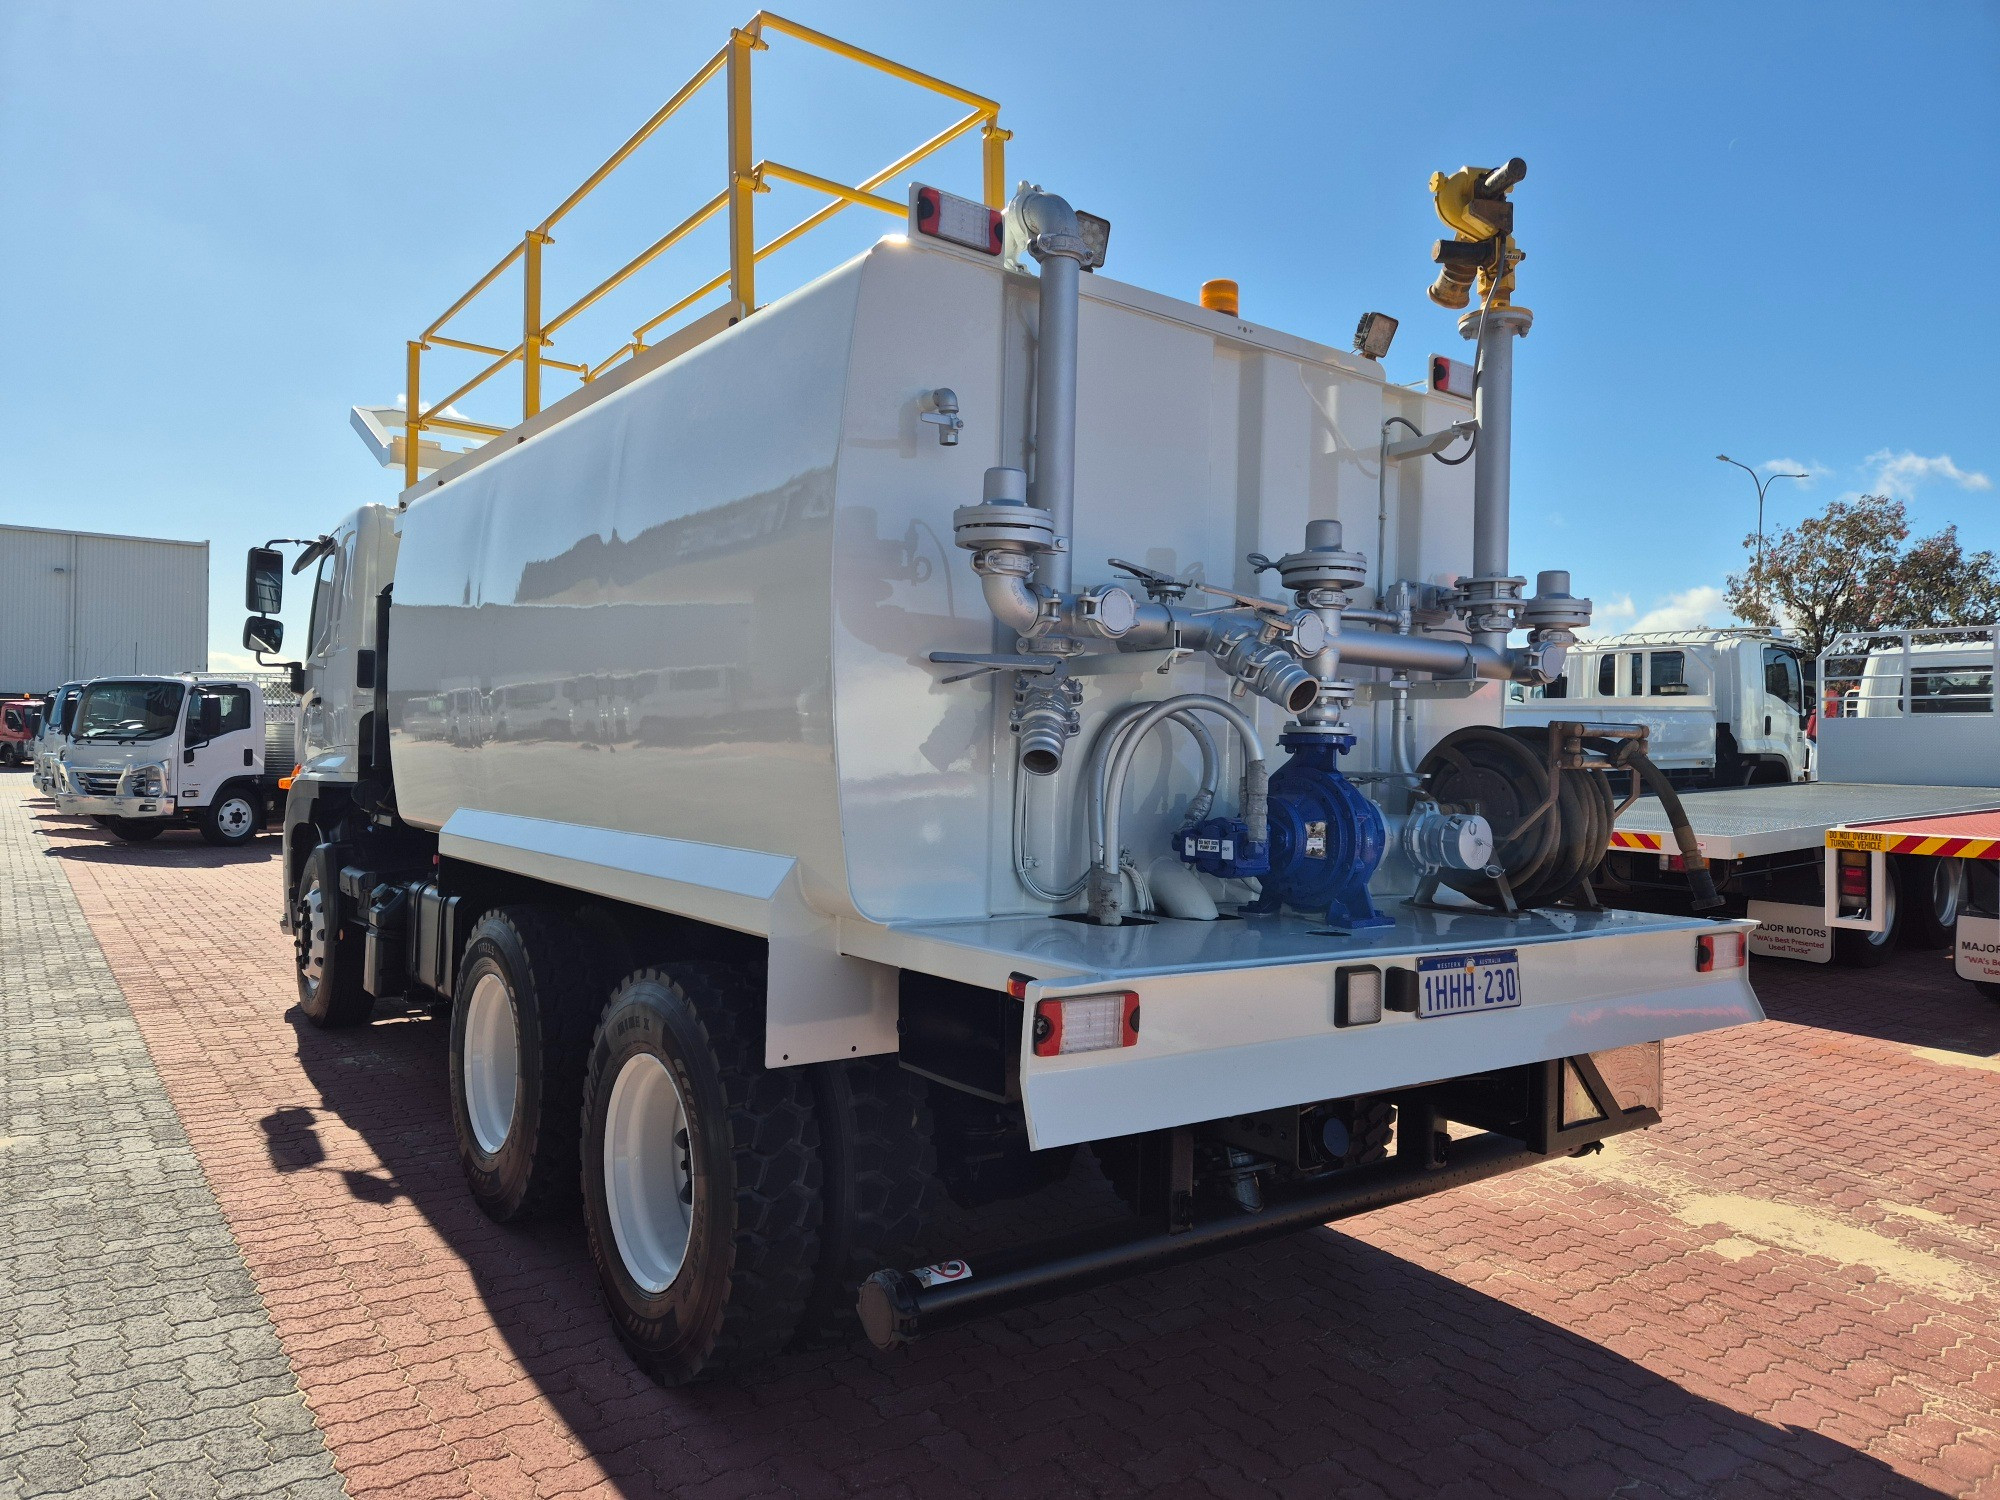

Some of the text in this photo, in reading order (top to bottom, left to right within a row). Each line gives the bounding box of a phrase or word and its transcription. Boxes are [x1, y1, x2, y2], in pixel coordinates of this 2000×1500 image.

[1829, 831, 1882, 842] DO NOT OVERTAKE
[1830, 839, 1882, 850] TURNING VEHICLE
[1786, 926, 1827, 938] MOTORS
[1791, 939, 1825, 949] Presented
[1436, 957, 1501, 969] WESTERN AUSTRALIA
[1983, 968, 2000, 976] Use
